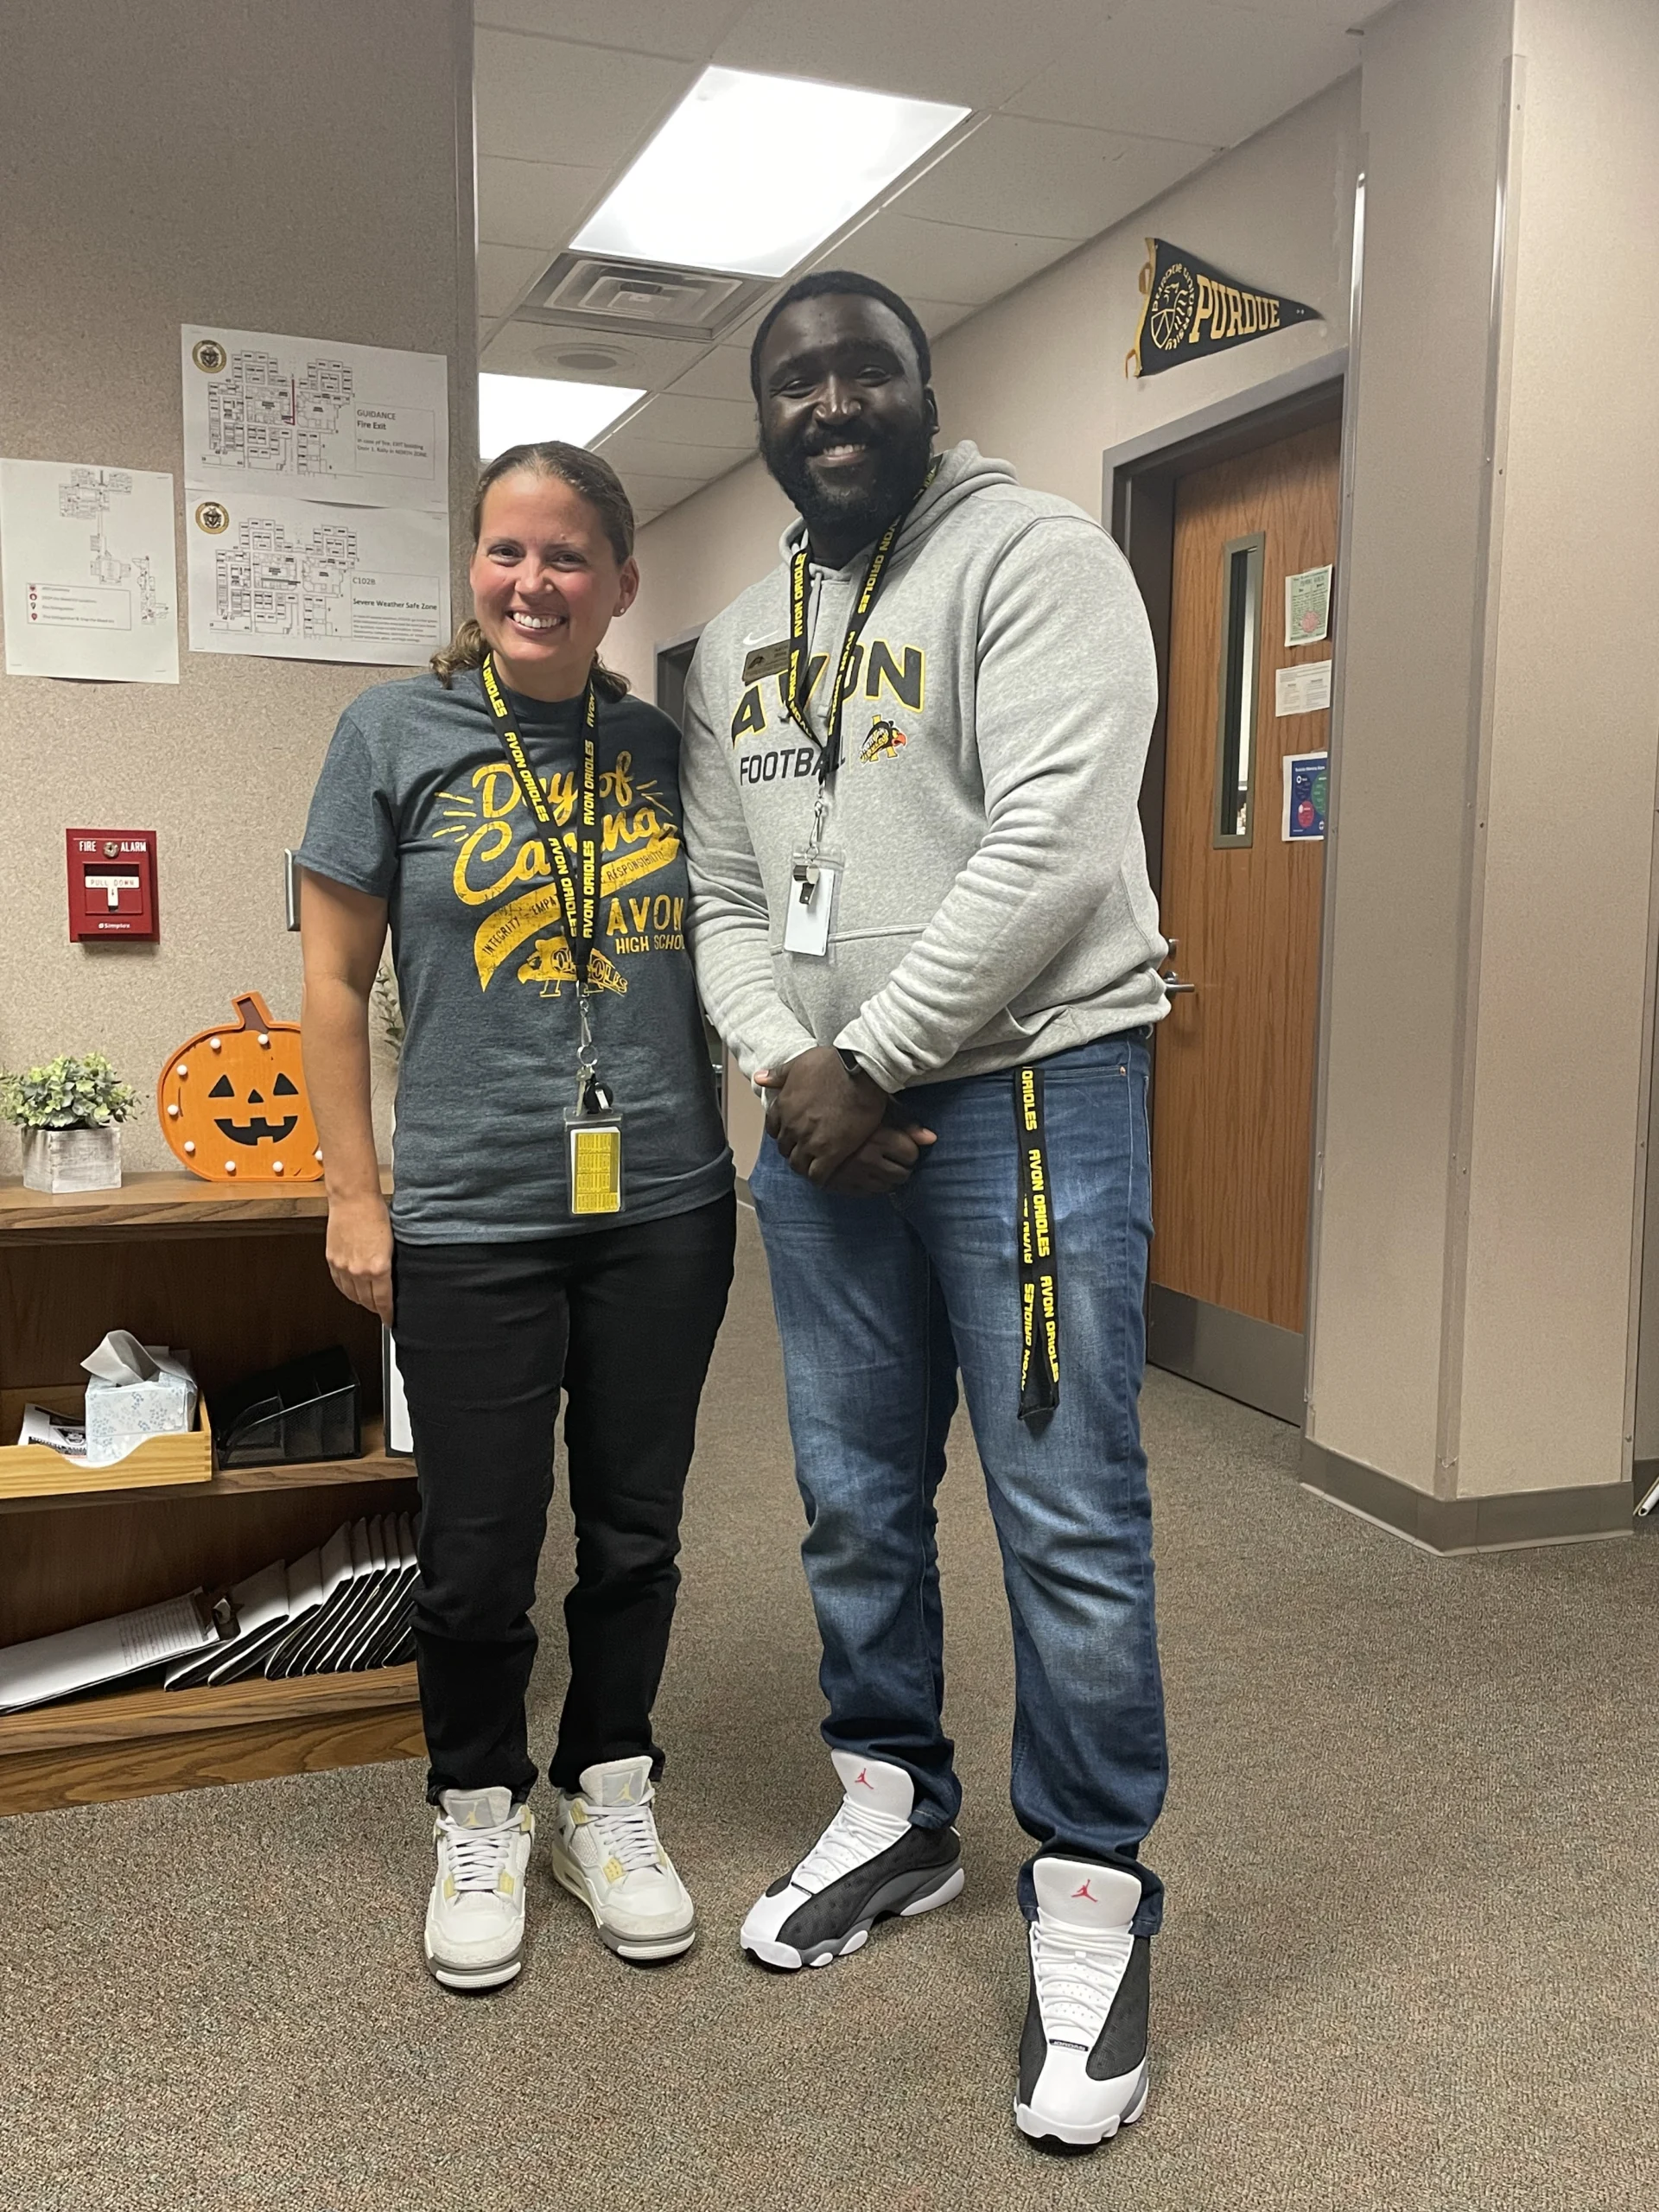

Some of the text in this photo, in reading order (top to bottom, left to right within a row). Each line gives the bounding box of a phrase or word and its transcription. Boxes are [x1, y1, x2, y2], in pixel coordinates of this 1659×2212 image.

[1189, 274, 1281, 344] PURDUE
[357, 410, 396, 420] GUIDANCE
[353, 598, 374, 607] Severe
[794, 553, 808, 638] AVON ORIOLE
[858, 555, 885, 613] ORIOLES
[482, 667, 508, 717] ORIOLES
[587, 694, 596, 728] AVON
[505, 732, 550, 823] AVON ORIOLES
[583, 740, 594, 826] AVON ORIOLES
[79, 841, 147, 852] FIRE ALARM
[548, 837, 569, 874] AVON
[583, 841, 594, 938] AVON ORIOLES
[607, 894, 683, 936] AVON
[482, 916, 520, 955] INTEGRITY
[615, 936, 650, 955] HIGH
[1022, 1071, 1037, 1131] ORIOLES
[1029, 1149, 1050, 1257] AVON ORIOLES
[1024, 1283, 1034, 1346] ORIOLES
[1040, 1275, 1059, 1382] AVON ORIOLES
